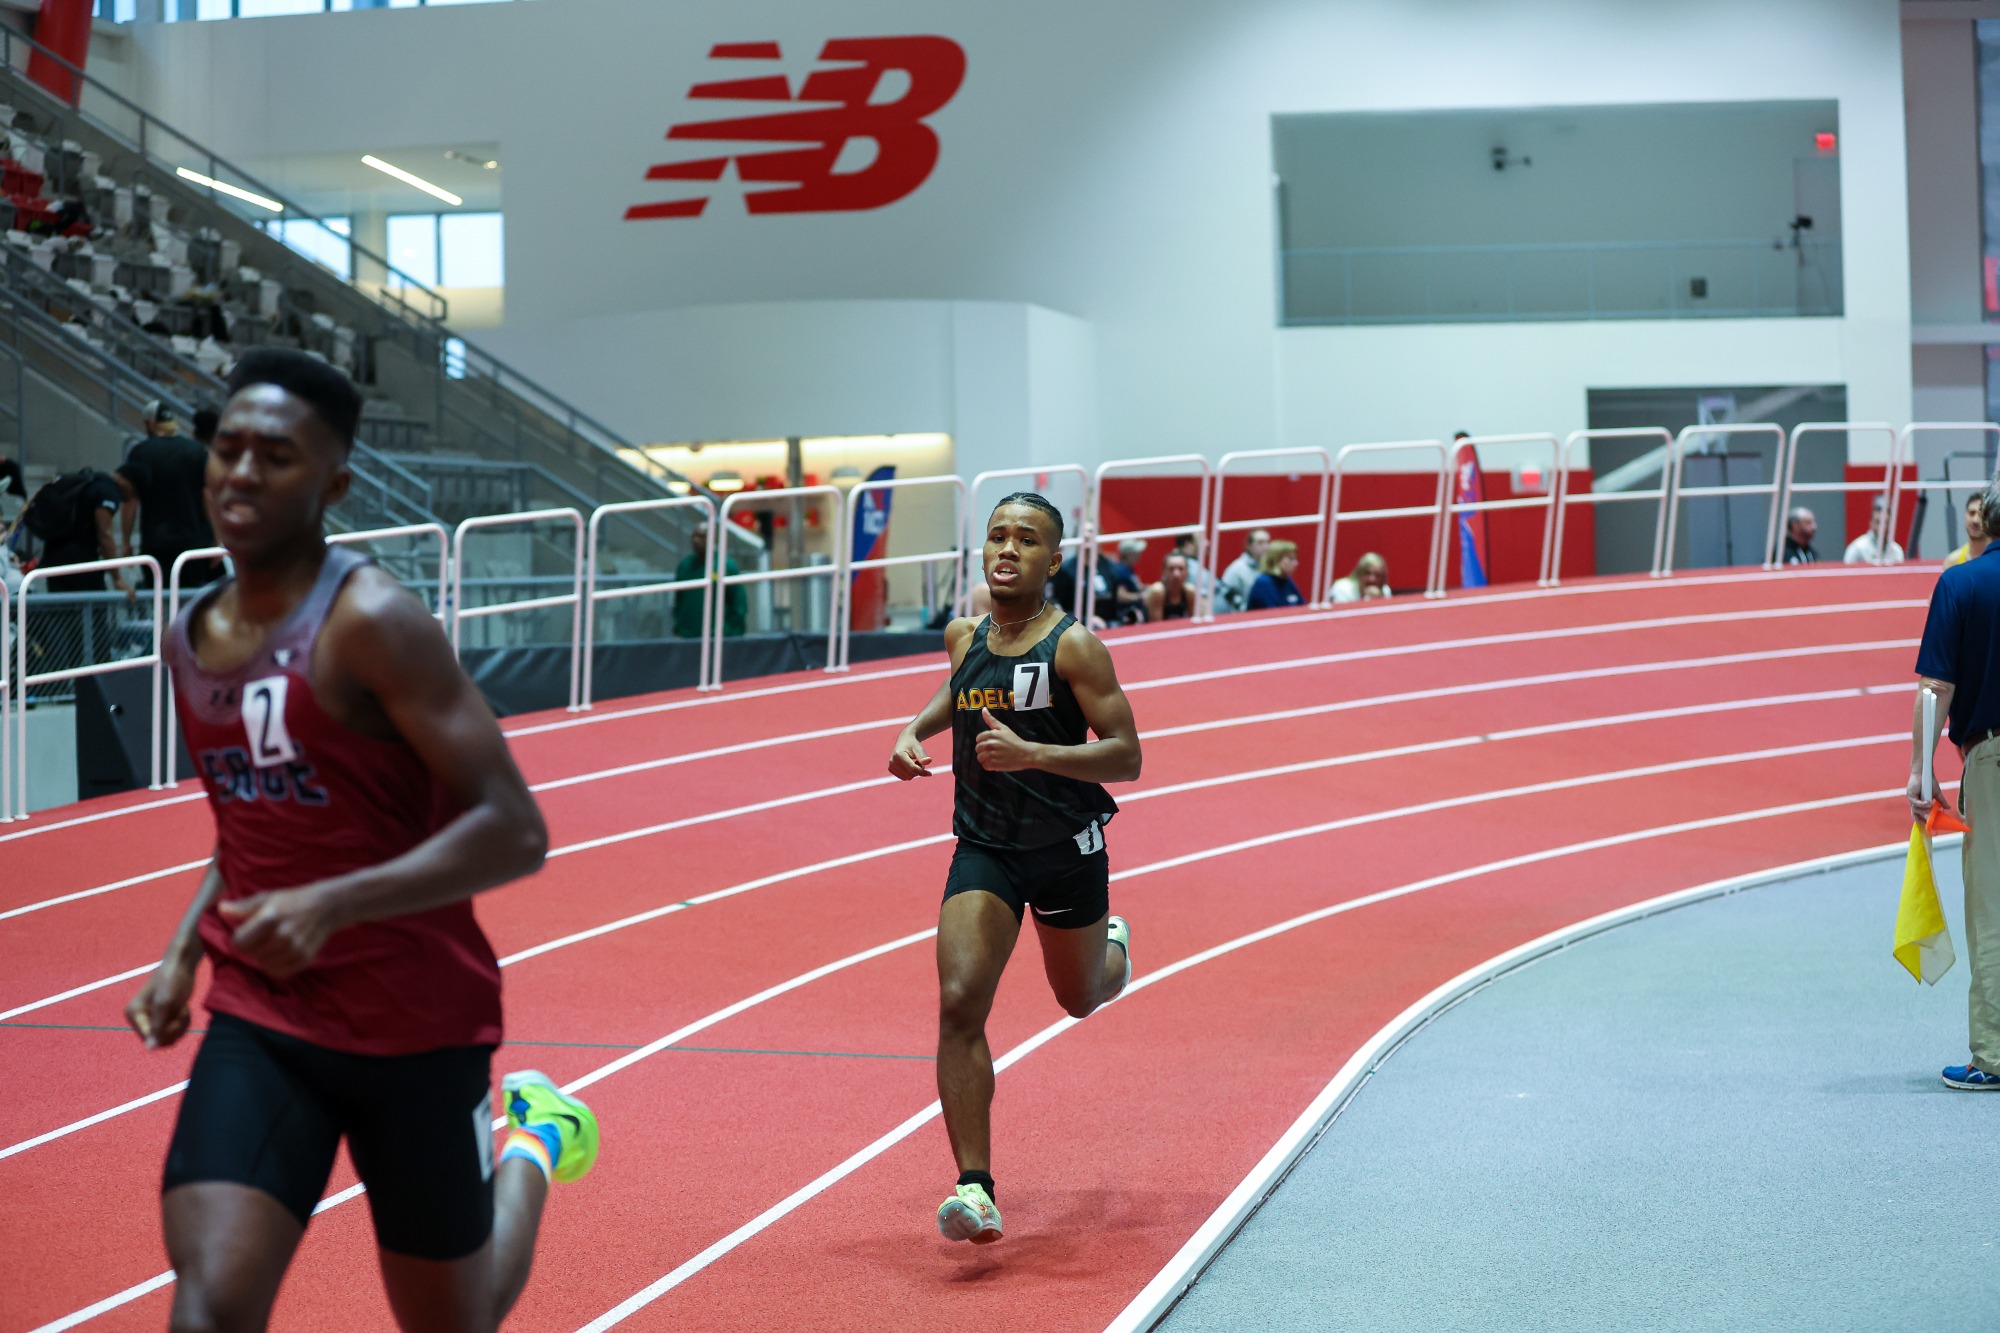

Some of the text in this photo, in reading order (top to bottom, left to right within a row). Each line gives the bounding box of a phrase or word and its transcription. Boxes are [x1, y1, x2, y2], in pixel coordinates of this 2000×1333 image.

[957, 687, 1054, 711] ADEL
[1020, 665, 1041, 708] 7
[253, 687, 282, 758] 2
